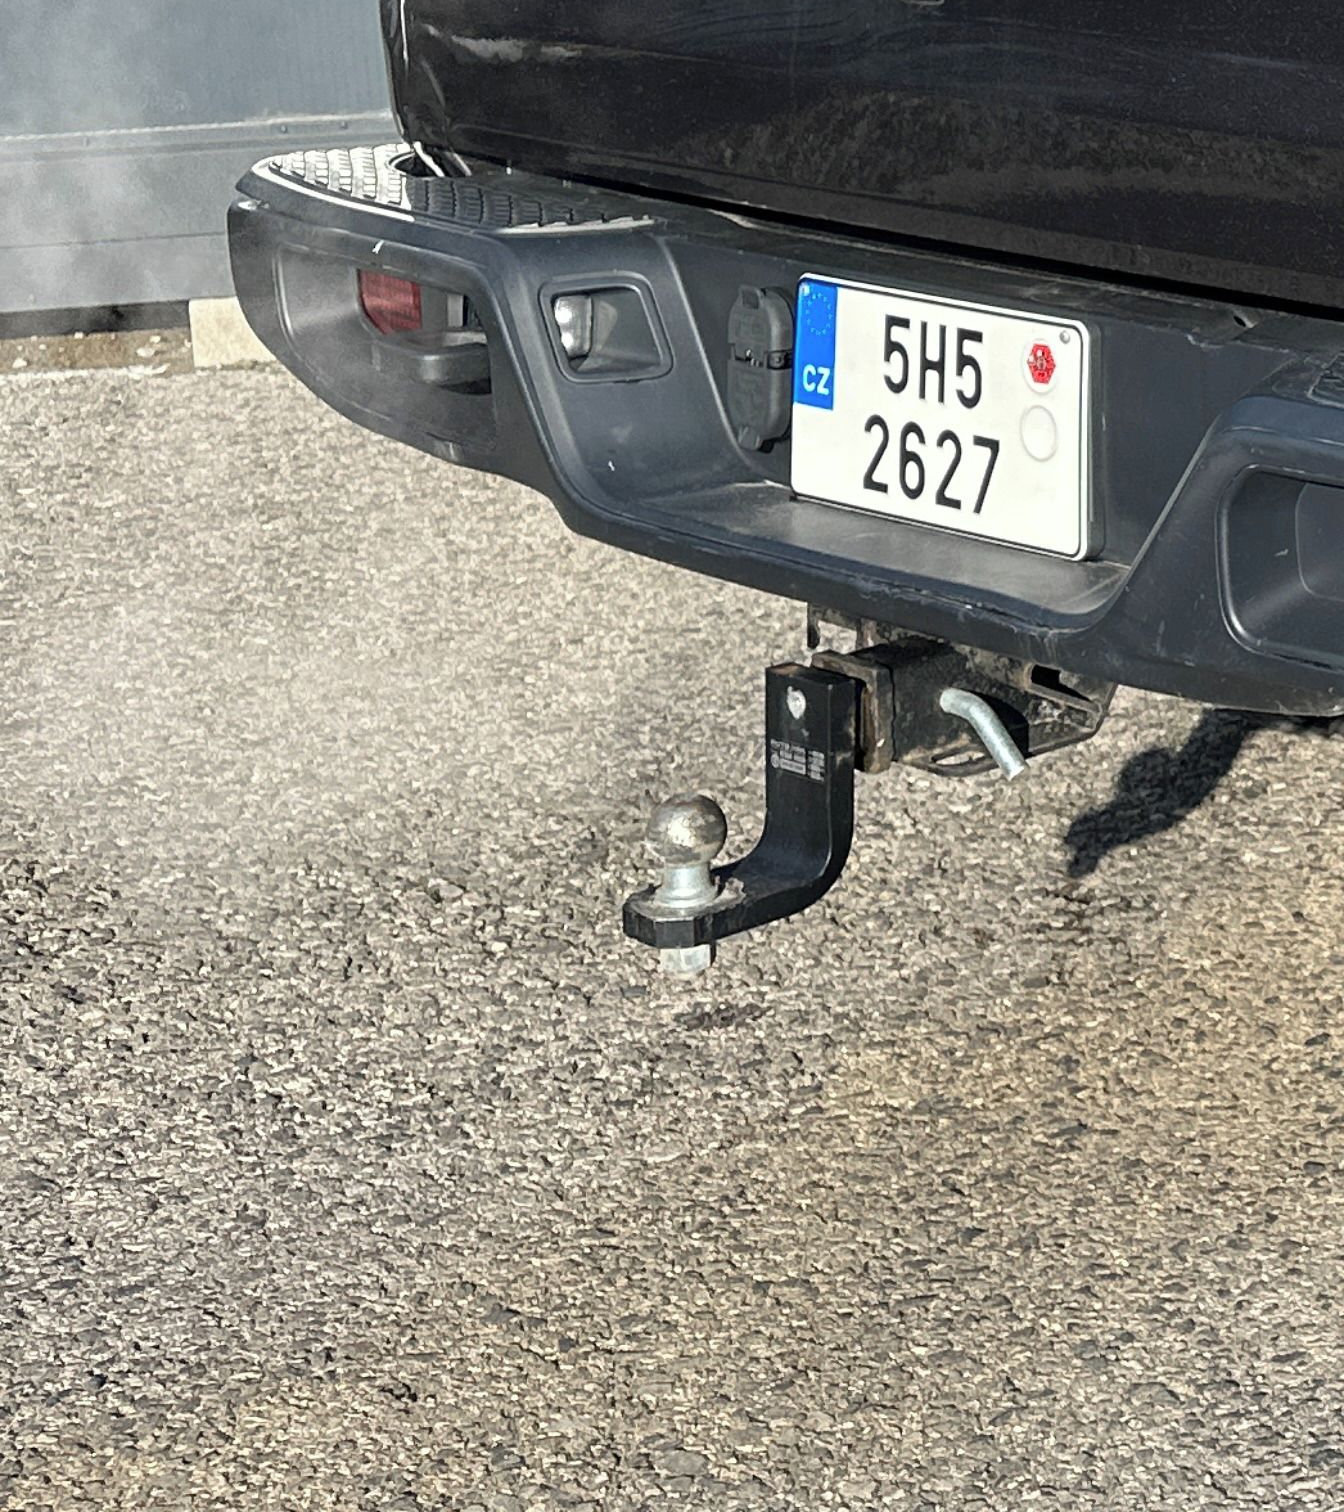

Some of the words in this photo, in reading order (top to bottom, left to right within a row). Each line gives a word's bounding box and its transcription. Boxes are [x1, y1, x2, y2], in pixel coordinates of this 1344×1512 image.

[802, 364, 830, 395] CZ
[884, 314, 983, 409] 5H5
[863, 414, 1000, 514] 2627
